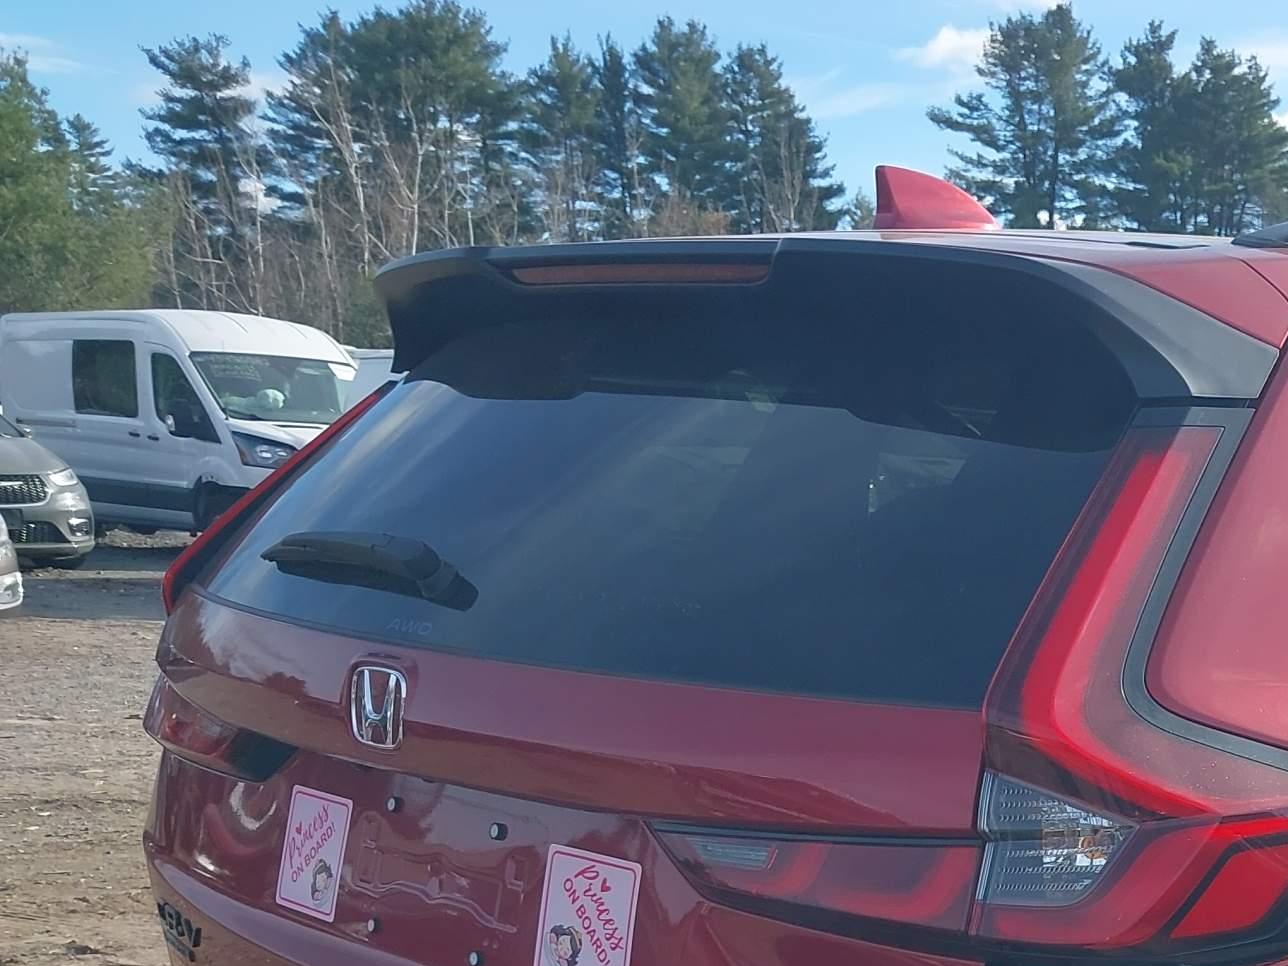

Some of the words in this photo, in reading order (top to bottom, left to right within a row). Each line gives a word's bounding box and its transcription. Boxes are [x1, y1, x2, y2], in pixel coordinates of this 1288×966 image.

[384, 618, 432, 635] AWD
[288, 804, 329, 869] Princess
[291, 863, 304, 883] ON
[304, 822, 336, 866] BOARD!
[563, 878, 580, 904] ON
[574, 865, 624, 950] Princess
